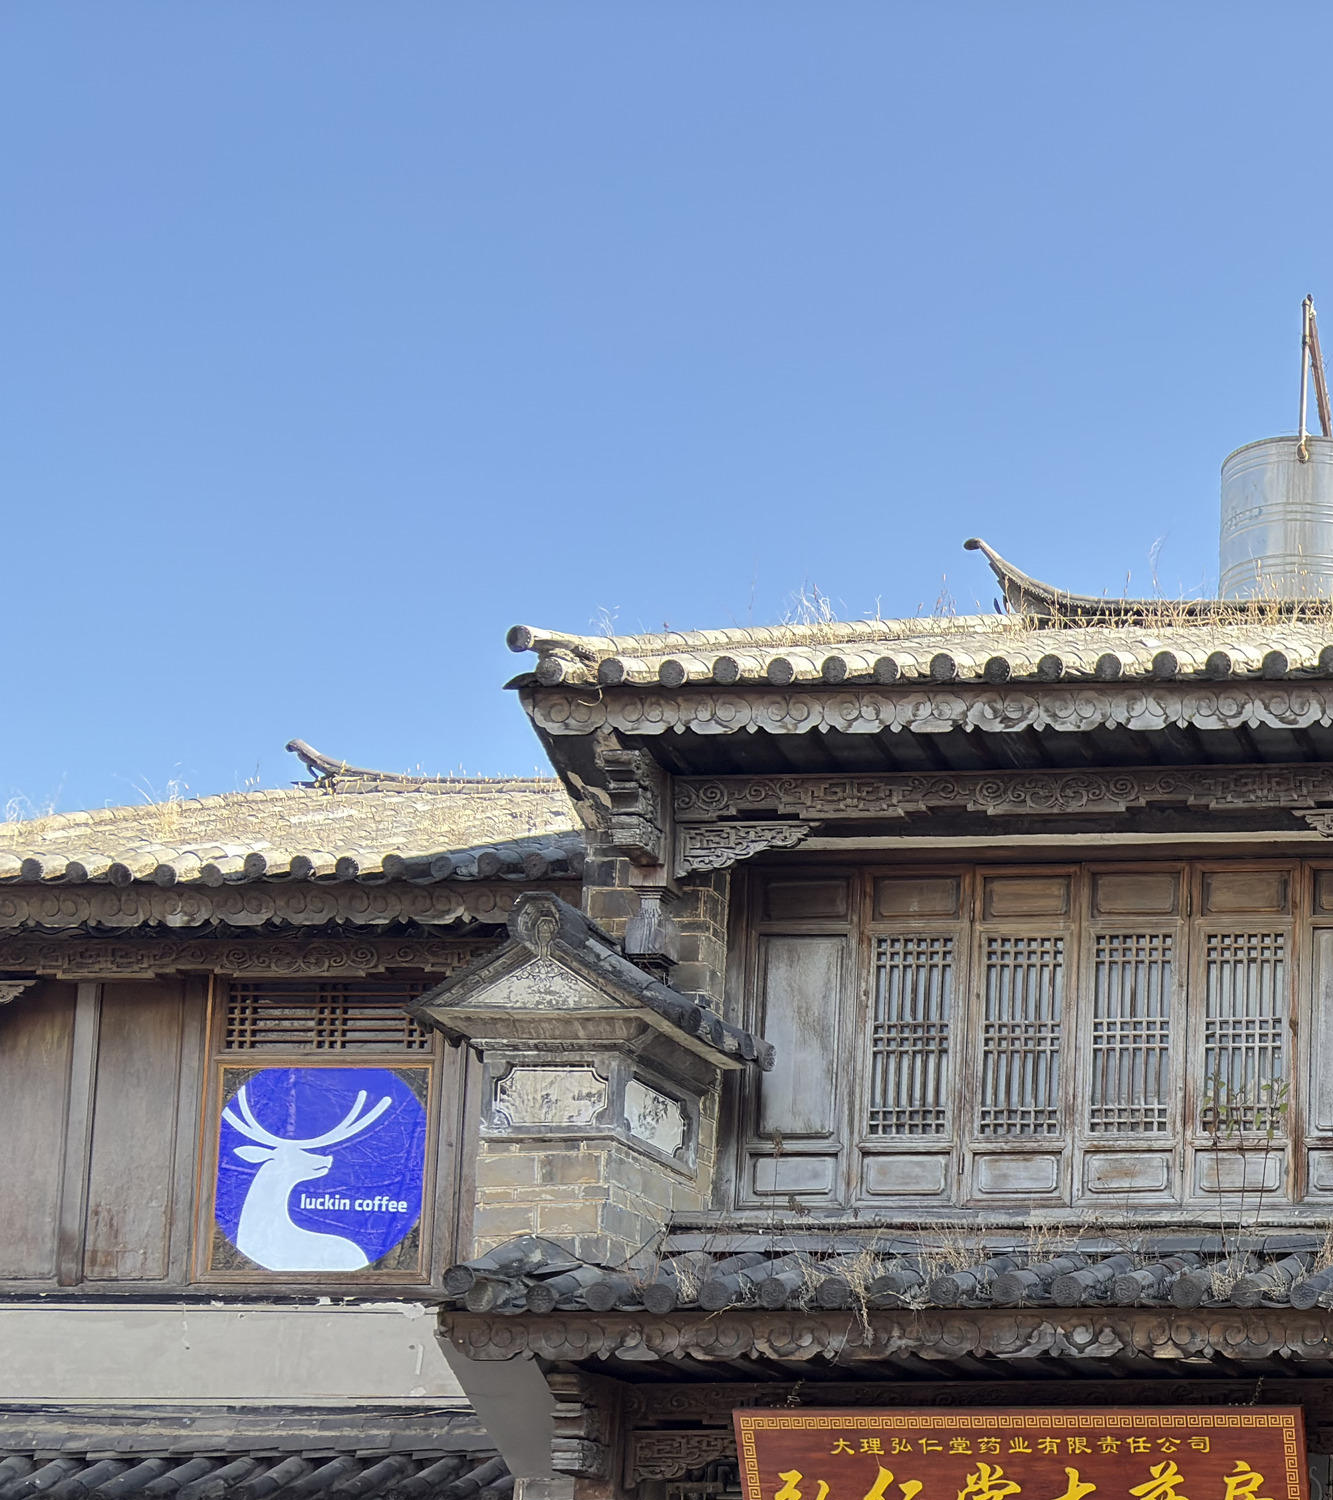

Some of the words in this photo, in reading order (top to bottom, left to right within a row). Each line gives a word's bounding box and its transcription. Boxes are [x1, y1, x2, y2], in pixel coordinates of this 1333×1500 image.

[299, 1194, 351, 1212] luckin
[354, 1194, 408, 1214] coffee
[830, 1434, 1212, 1456] 大理弘仁堂药业有限责任公司
